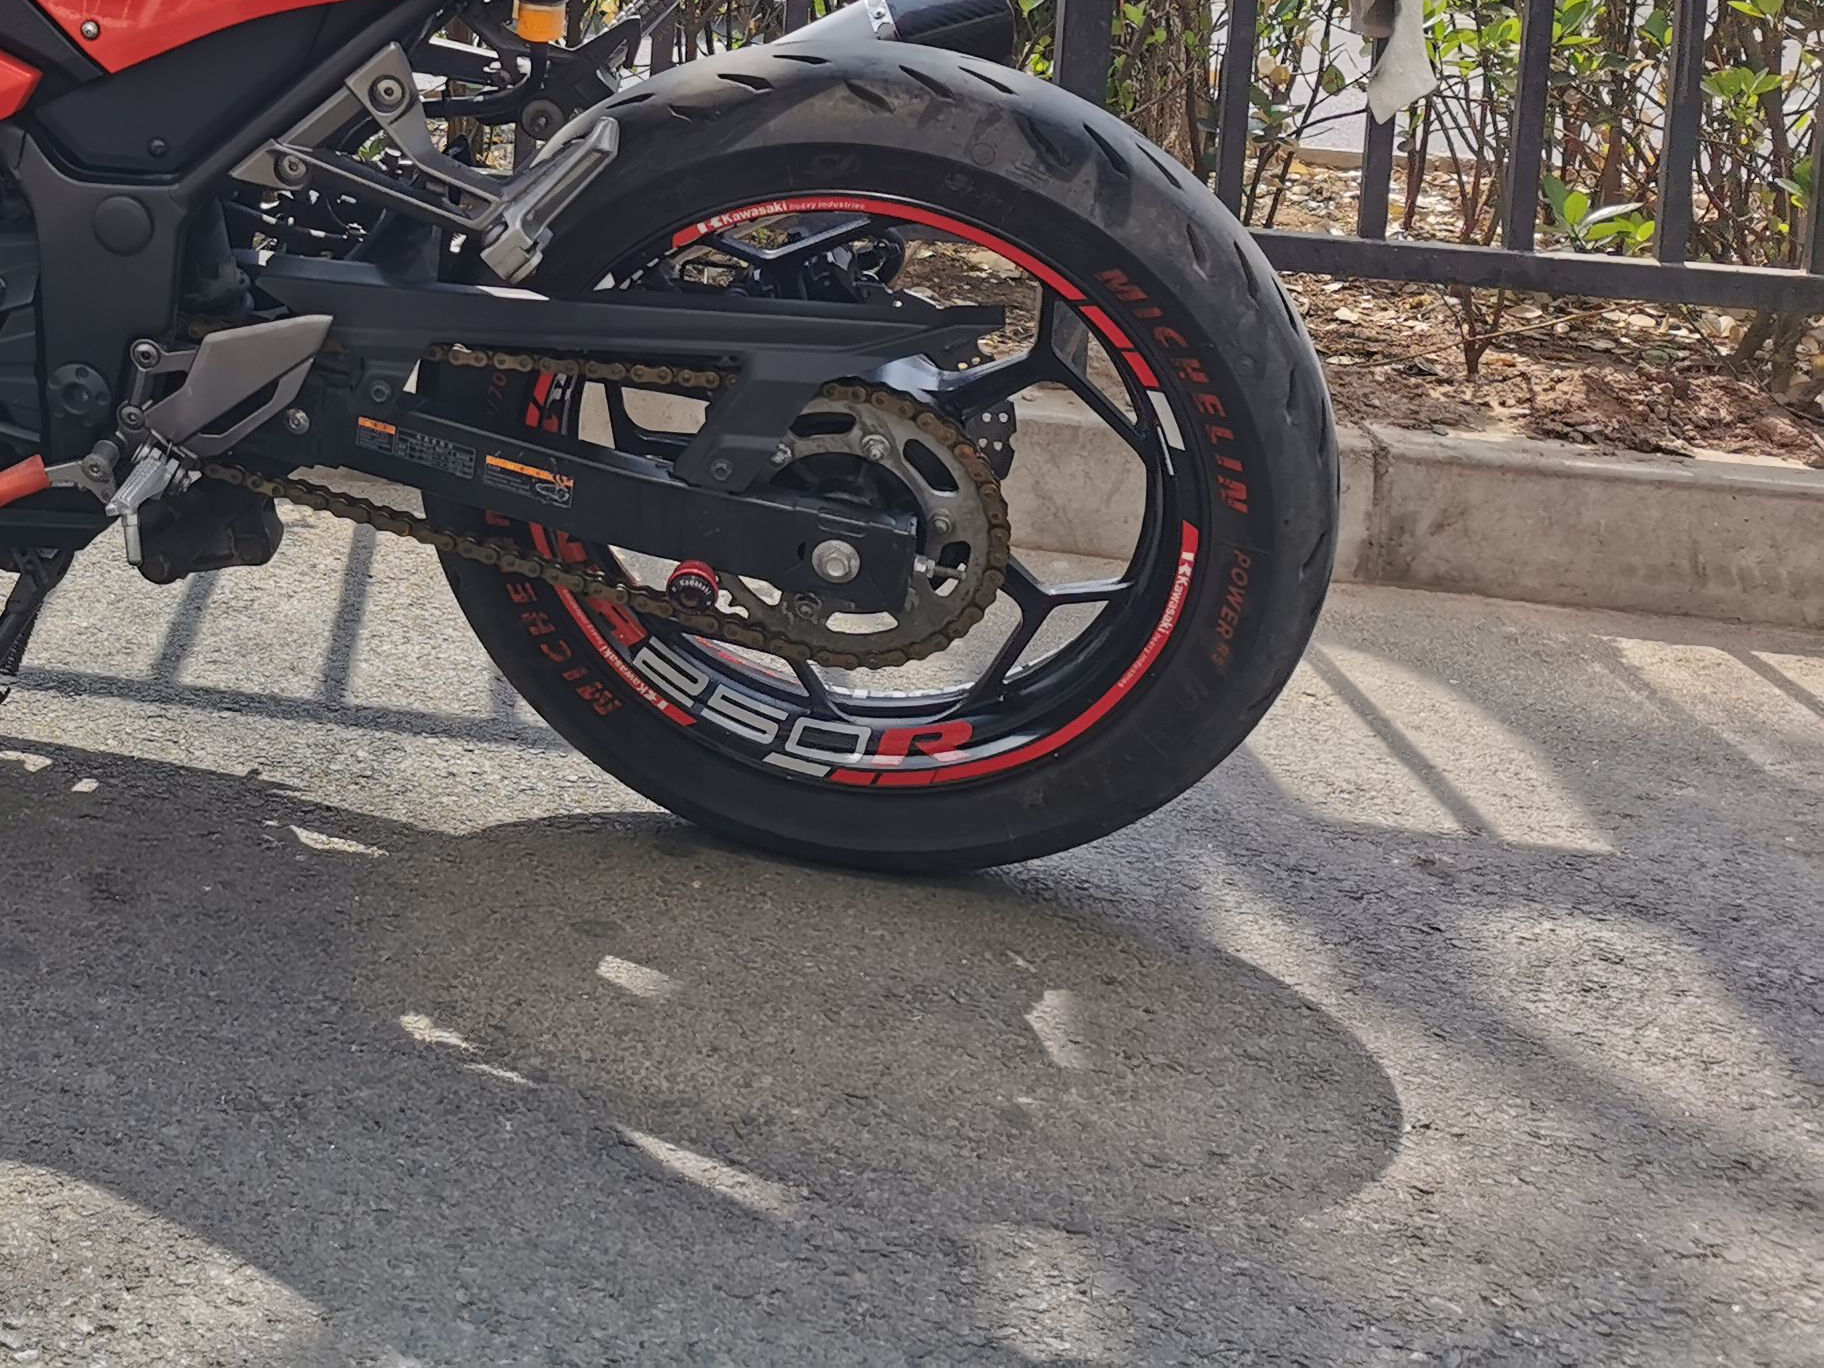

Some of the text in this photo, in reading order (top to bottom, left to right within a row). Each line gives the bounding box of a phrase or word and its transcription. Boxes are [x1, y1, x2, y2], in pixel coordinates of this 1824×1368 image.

[721, 200, 789, 227] Kawasaki
[1093, 268, 1249, 515] MICHELIN
[1157, 574, 1190, 635] Kawasaki
[1215, 549, 1252, 641] POWER
[599, 643, 652, 699] Kawasaki
